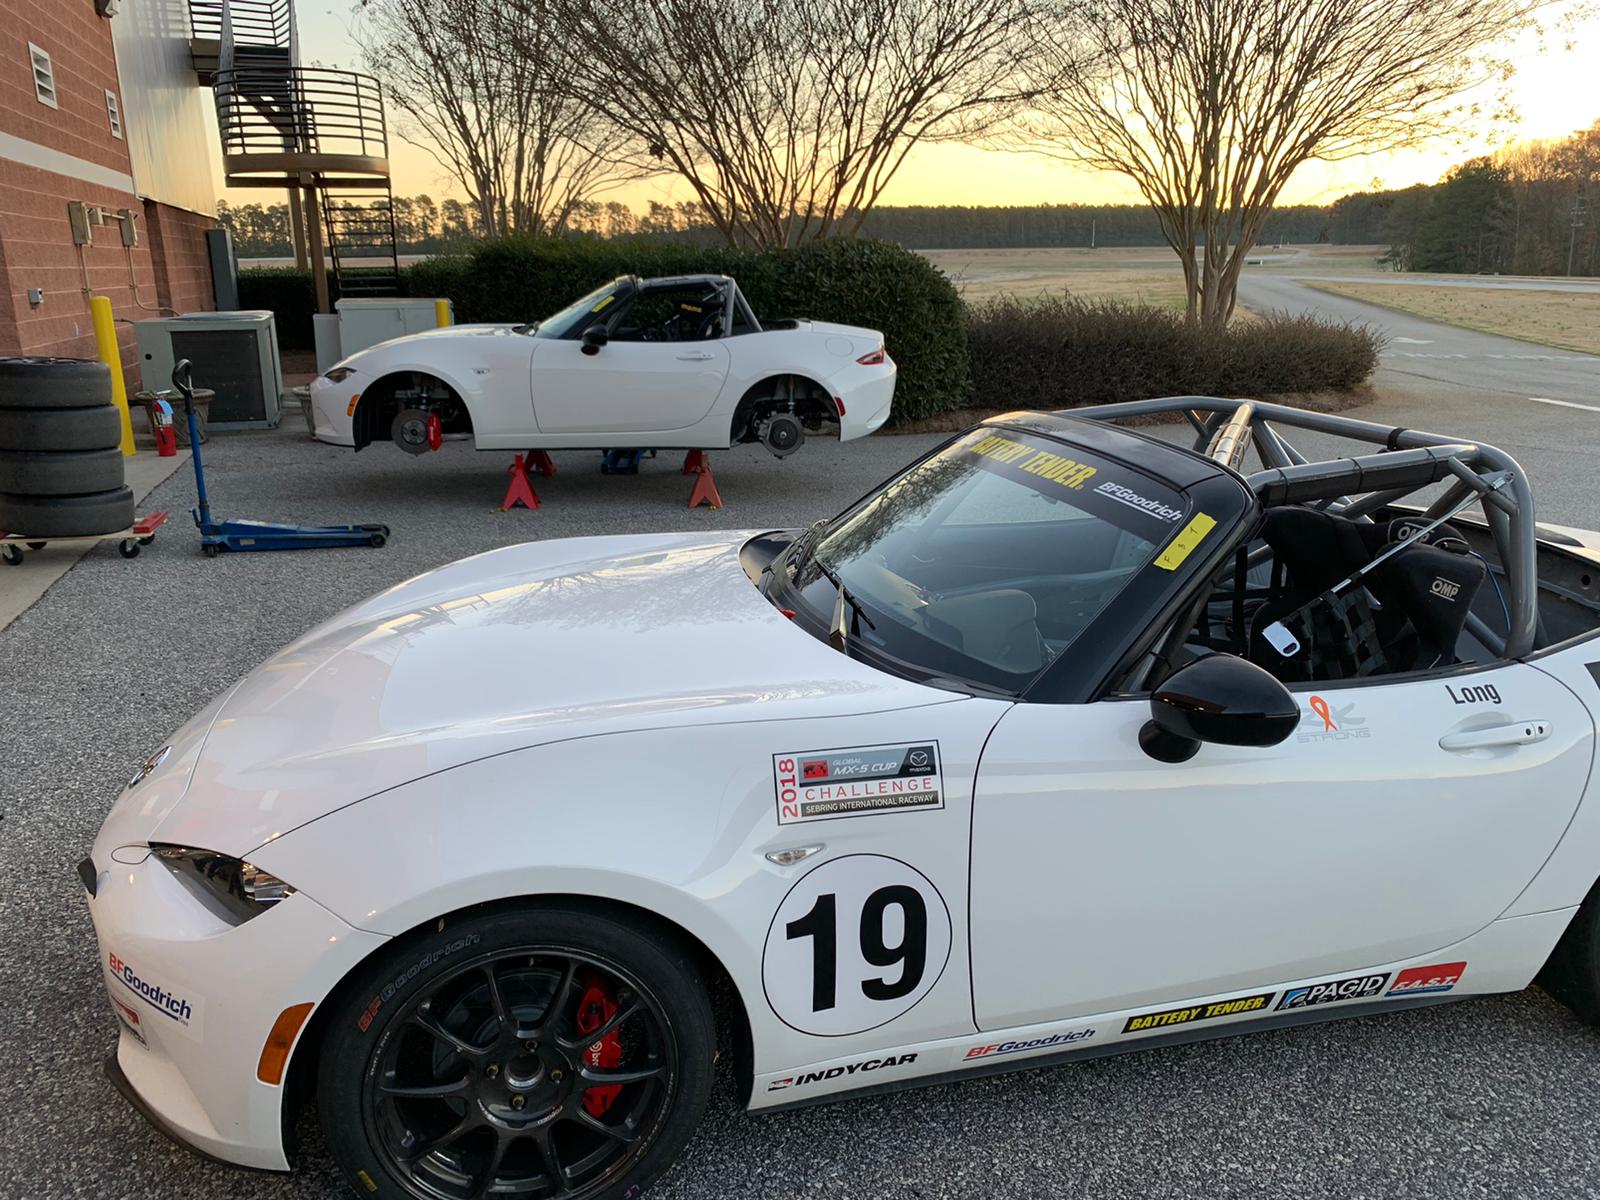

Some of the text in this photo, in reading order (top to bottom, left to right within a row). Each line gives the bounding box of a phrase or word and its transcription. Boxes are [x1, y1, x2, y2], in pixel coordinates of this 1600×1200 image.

[1018, 451, 1097, 489] TENDER
[1098, 481, 1182, 521] BFGoodrich
[1432, 580, 1459, 598] OMP
[1445, 683, 1502, 705] Long
[1296, 727, 1371, 743] STRONG
[833, 762, 898, 776] MX-5 CUP
[779, 758, 798, 818] 2018
[804, 778, 933, 800] CHALLENGE
[806, 794, 934, 814] SEBRING INTERNATIONAL RACEWAY
[786, 884, 927, 1013] 19
[109, 951, 192, 1020] BFGoodrich
[1308, 976, 1384, 1001] PAGID
[1129, 997, 1265, 1030] BATTERY TENDER
[965, 1028, 1096, 1058] BFGoodrich
[795, 1053, 918, 1085] INDYCAR
